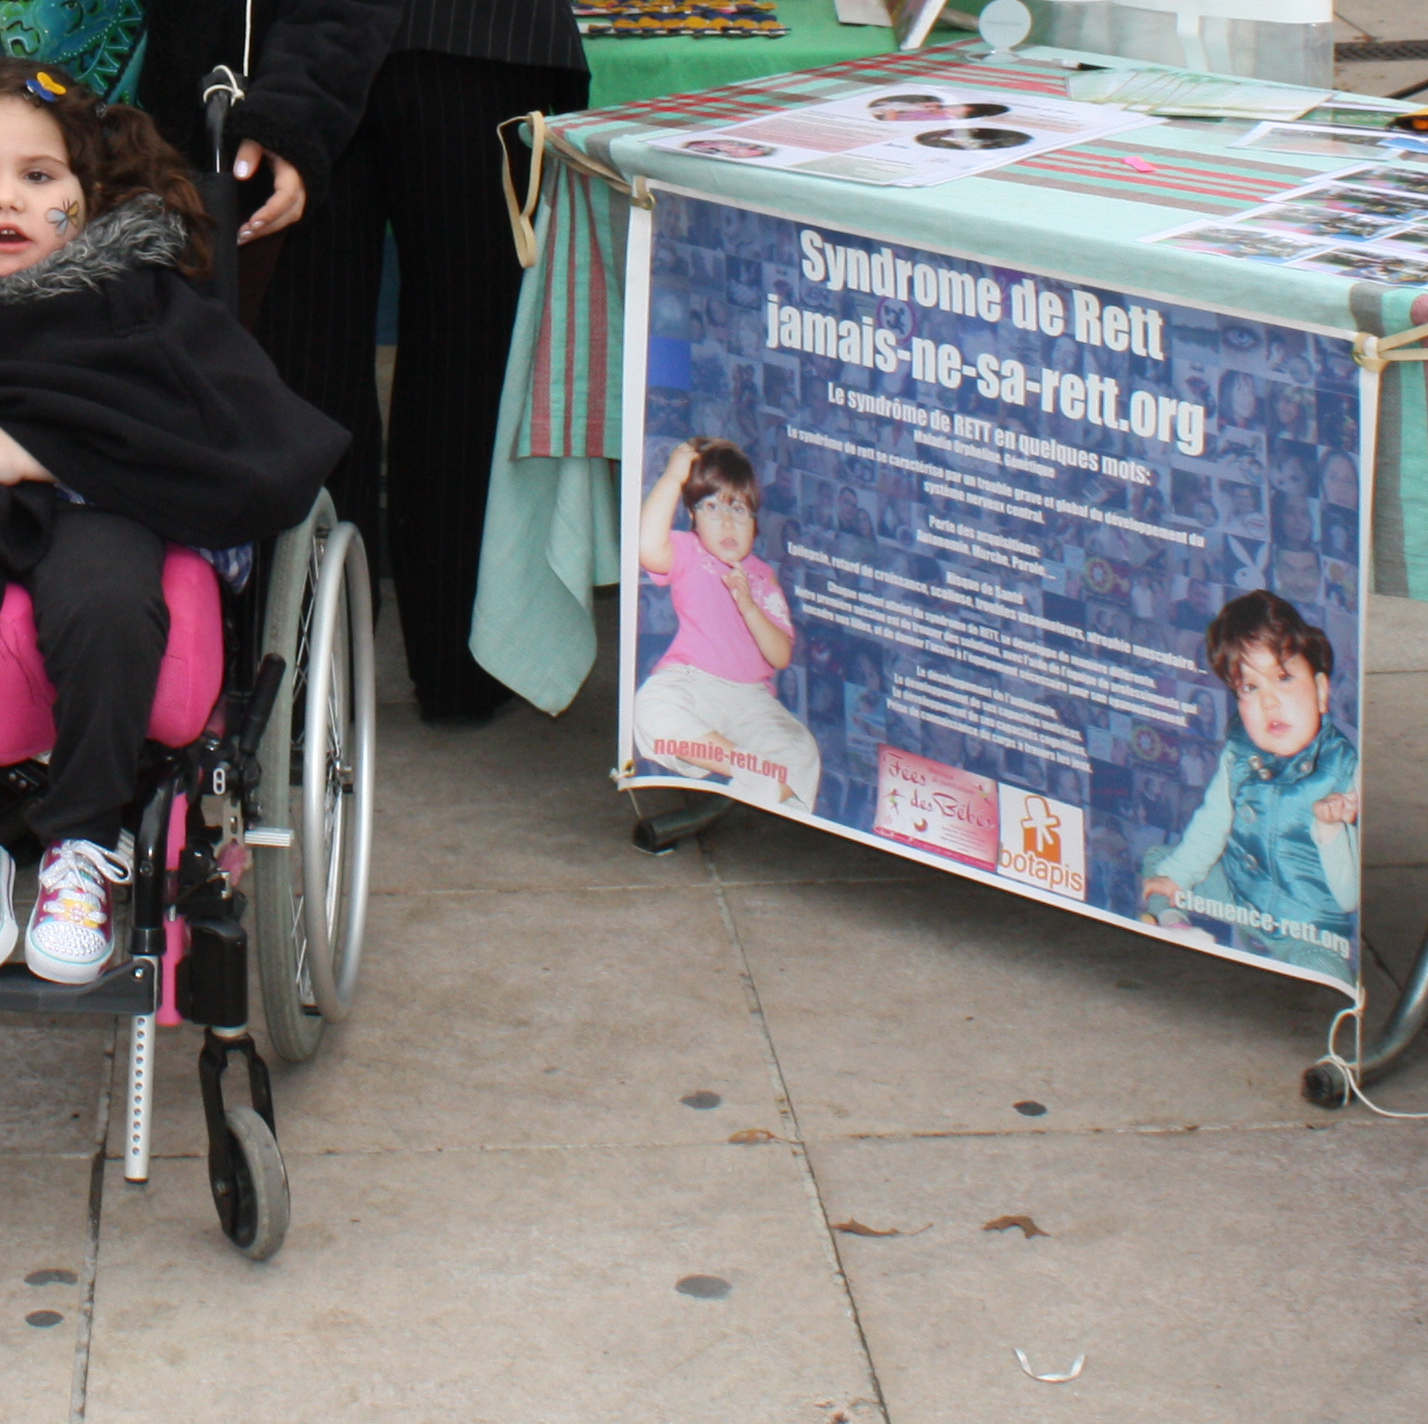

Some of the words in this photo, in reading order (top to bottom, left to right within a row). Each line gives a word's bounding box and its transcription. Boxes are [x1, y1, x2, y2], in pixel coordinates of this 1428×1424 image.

[800, 230, 1002, 323] Syndrome
[1010, 279, 1065, 337] de
[1072, 289, 1165, 360] Rett
[765, 294, 1206, 457] jamais-ne-sa-rett.org
[828, 382, 846, 406] Le
[847, 389, 928, 426] syndrôme
[930, 410, 951, 433] de
[954, 414, 993, 444] RETT
[995, 428, 1016, 451] en
[1019, 434, 1100, 472] quelques
[1102, 455, 1153, 486] mots:
[654, 738, 788, 784] noemie-rett.org
[1174, 889, 1351, 958] clemence-rett.org
